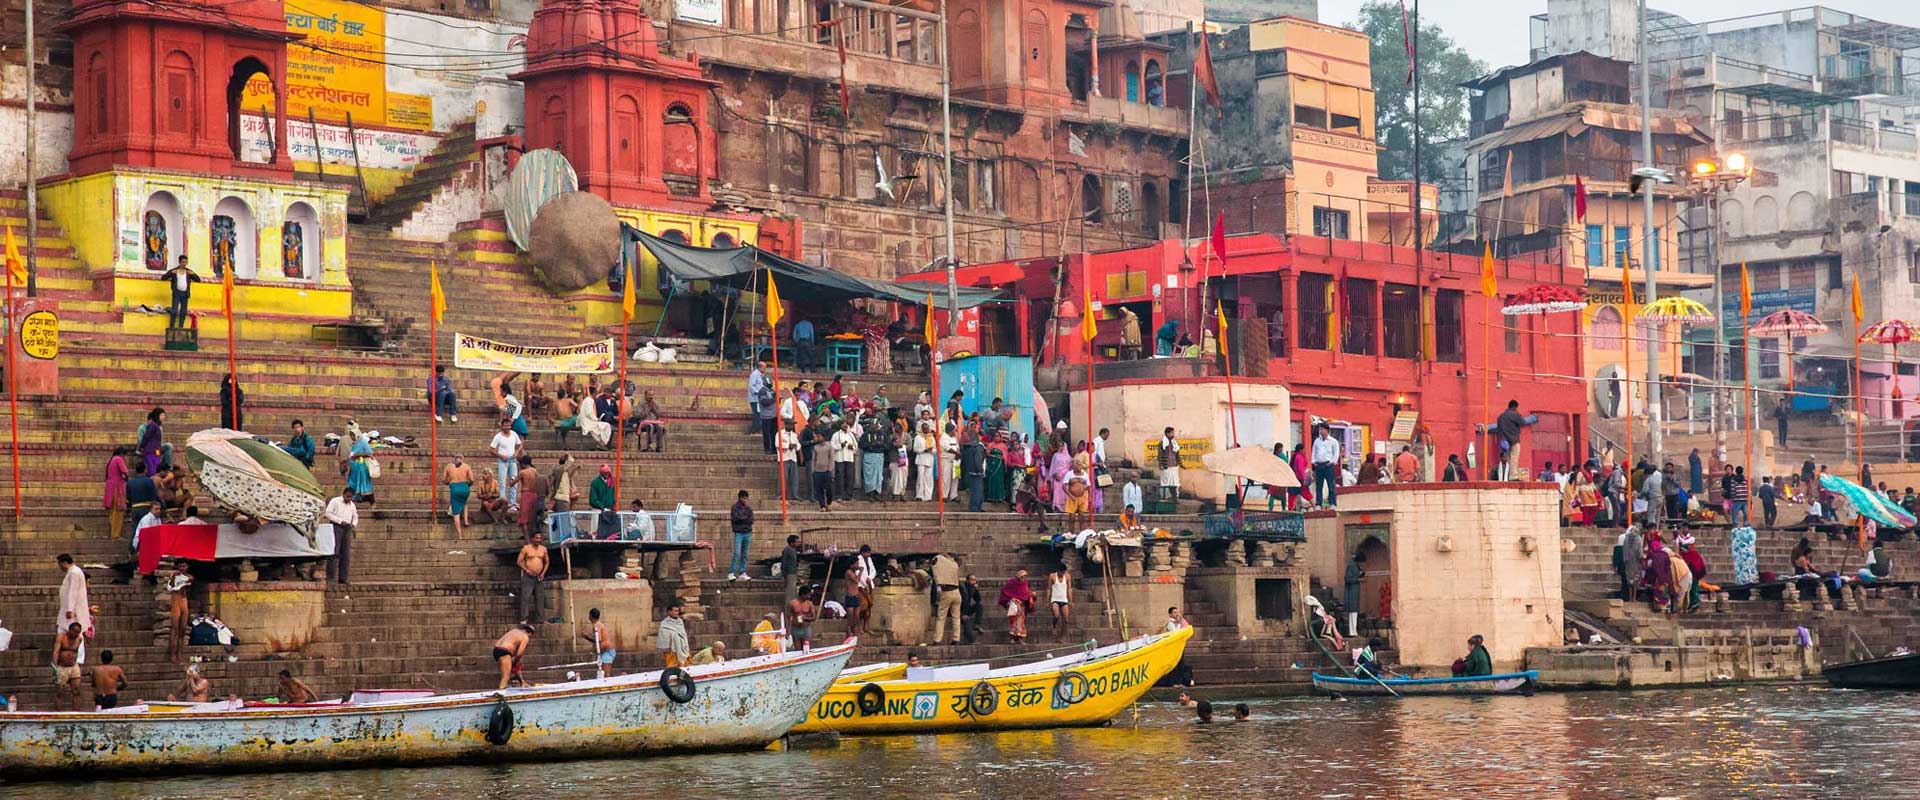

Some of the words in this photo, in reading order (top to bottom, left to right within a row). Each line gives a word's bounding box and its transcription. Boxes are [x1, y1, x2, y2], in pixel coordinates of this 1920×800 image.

[285, 13, 312, 29] ल्या
[248, 79, 273, 96] सुल
[1110, 661, 1150, 694] BANK
[1006, 681, 1045, 708] बैंक
[817, 700, 856, 719] UCO
